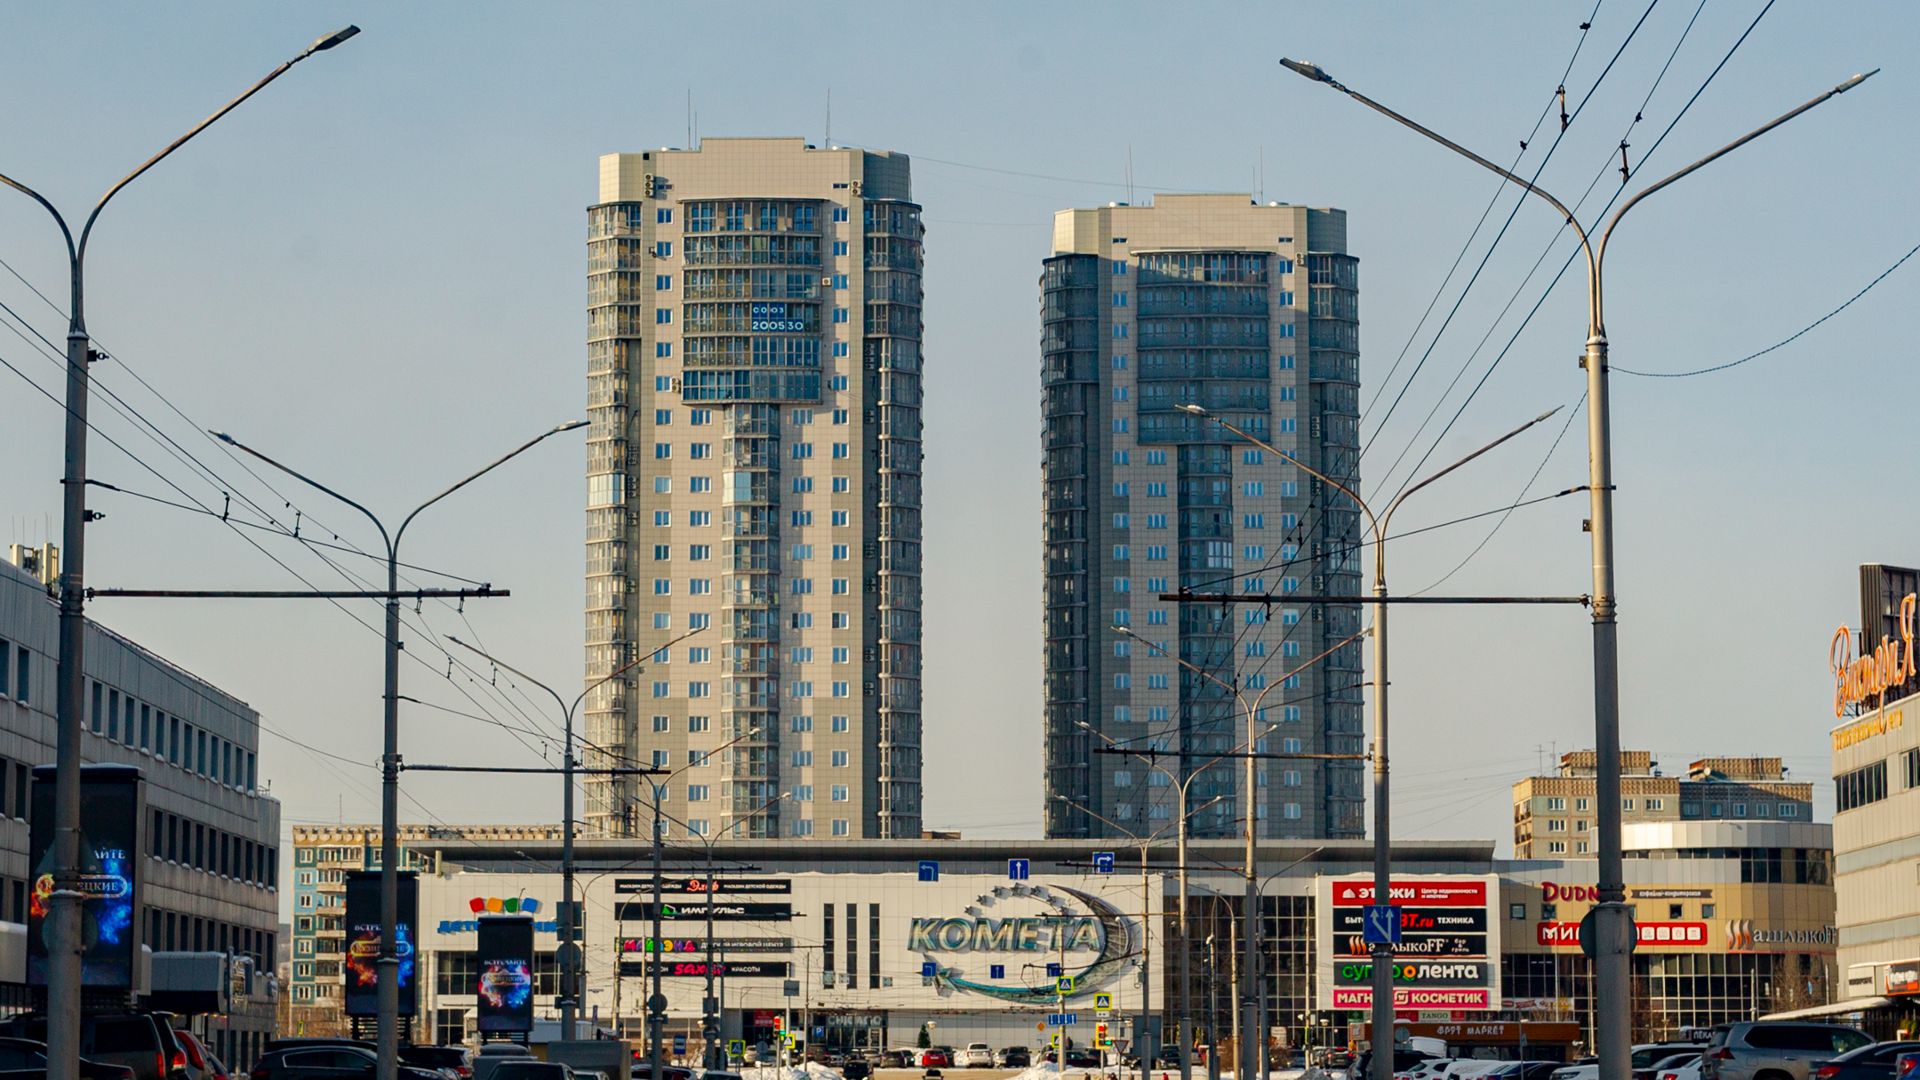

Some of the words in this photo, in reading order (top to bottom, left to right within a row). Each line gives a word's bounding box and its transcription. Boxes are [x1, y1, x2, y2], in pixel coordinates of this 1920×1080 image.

[1359, 887, 1415, 899] ЭТЖИ
[1400, 913, 1434, 928] BT.ru
[1437, 916, 1474, 924] ТЕХНИКА
[908, 917, 1101, 951] КОМЕТА
[624, 938, 695, 952] МАЙЭНД
[1417, 965, 1479, 979] лента
[1336, 993, 1374, 1004] МАГН
[1411, 993, 1483, 1004] КОСМЕТИК
[1421, 1010, 1449, 1019] TANGO
